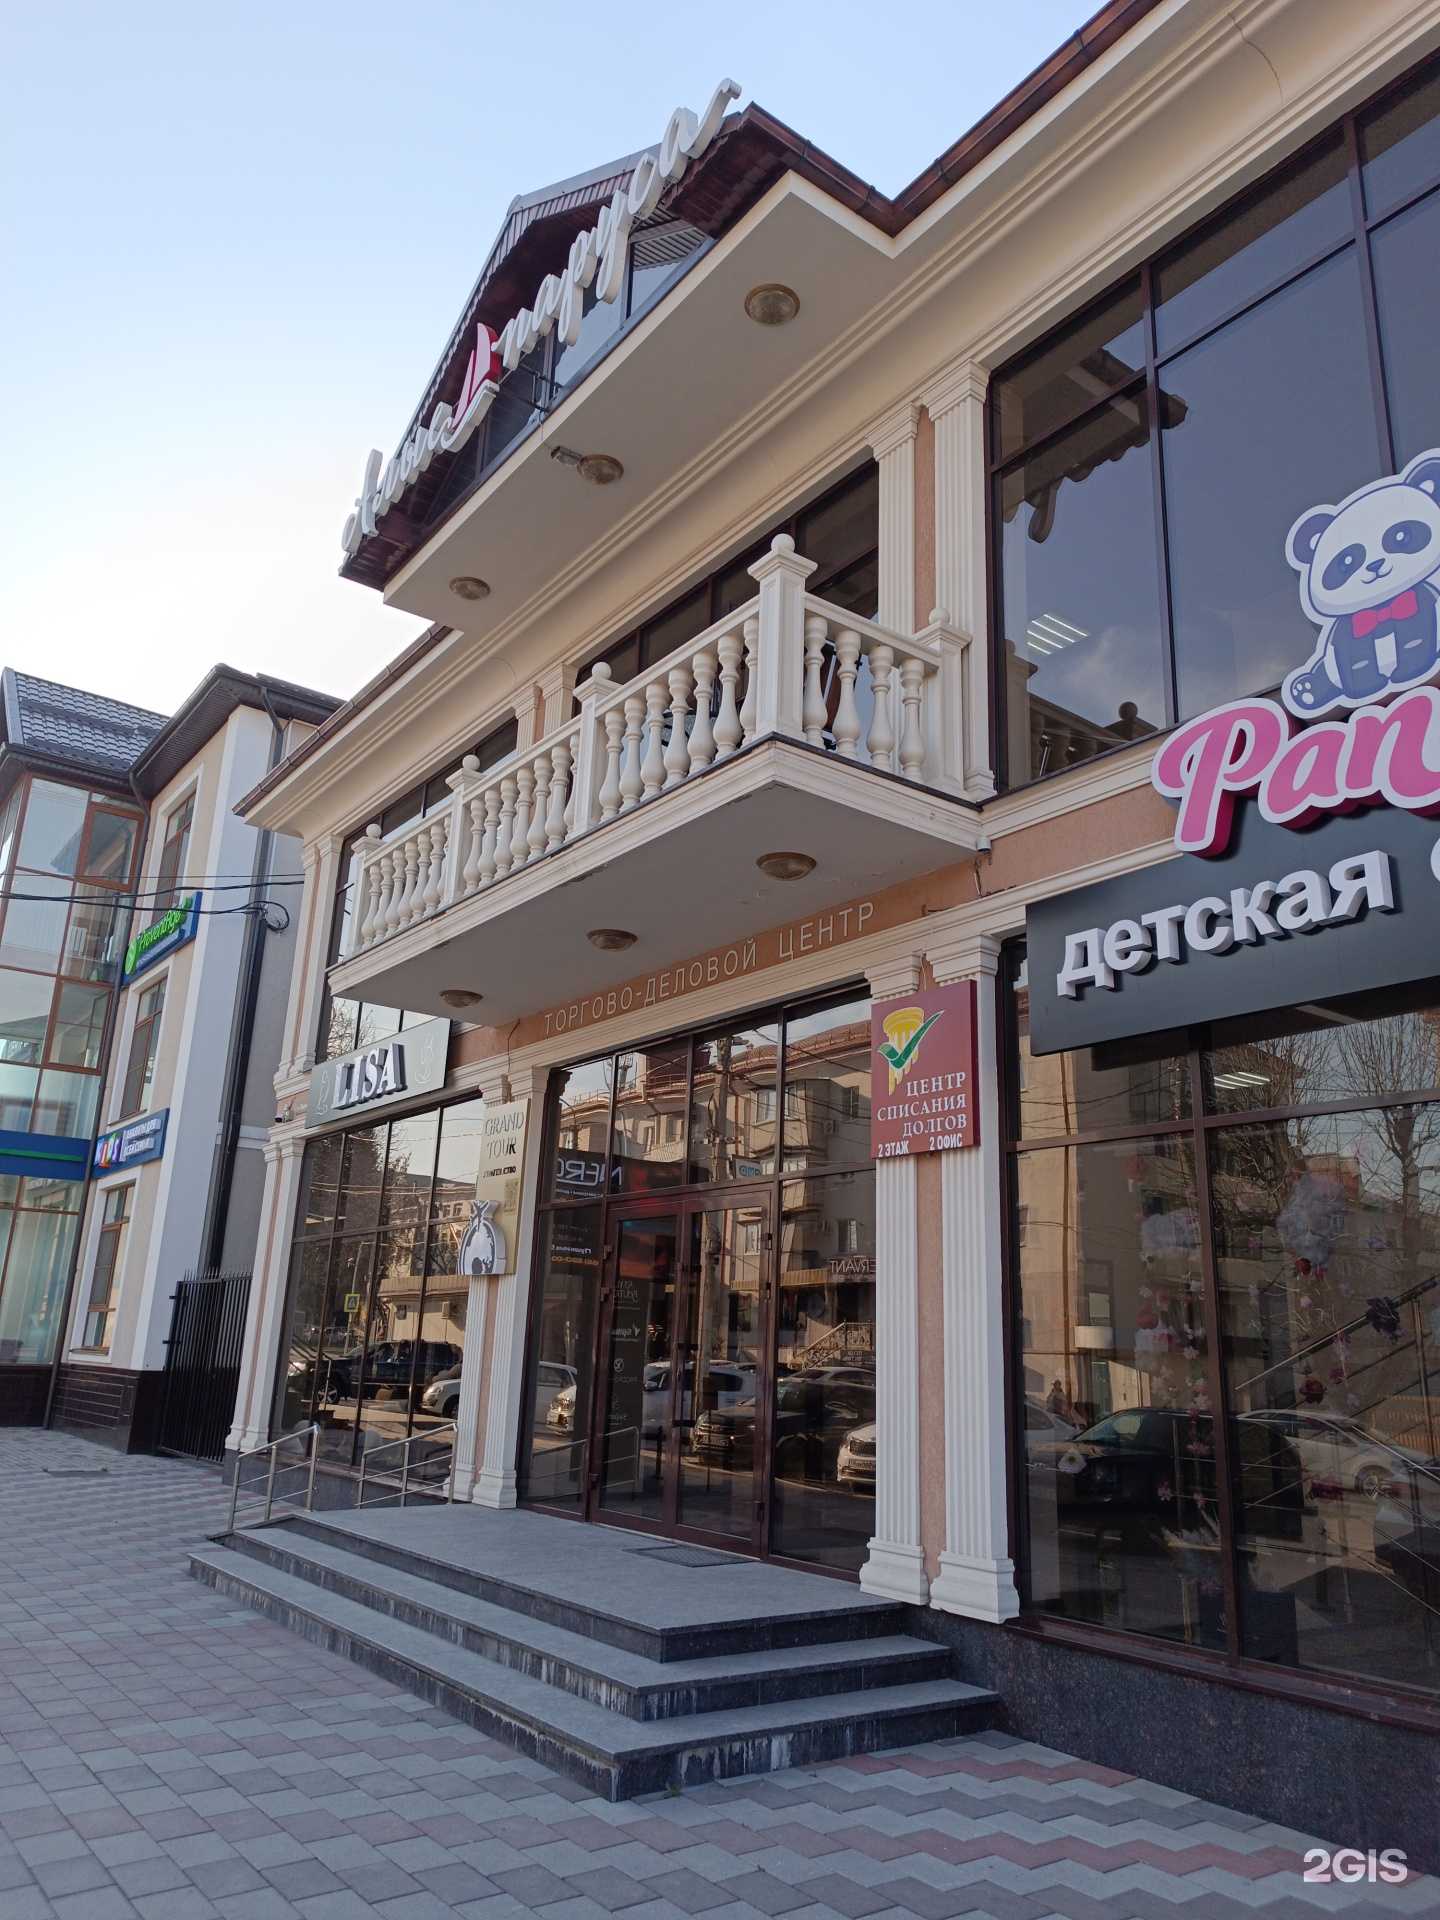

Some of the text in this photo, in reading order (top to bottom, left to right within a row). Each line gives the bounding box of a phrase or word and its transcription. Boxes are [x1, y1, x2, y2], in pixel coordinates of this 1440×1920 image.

[491, 77, 742, 371] паруса
[1057, 850, 1394, 998] детская
[544, 902, 875, 1035] ТОРГОВО-ДЕЛОВОЙ ЦЕНТР
[331, 1042, 403, 1109] LISA
[906, 1071, 966, 1097] ЦЕНТР
[877, 1094, 966, 1122] СПИСАНИЯ
[485, 1111, 525, 1137] GRAND
[902, 1113, 967, 1138] ДОЛГОВ
[486, 1136, 516, 1159] TOUR
[878, 1132, 963, 1158] 2 ЭТАЖ 2 ОФИС
